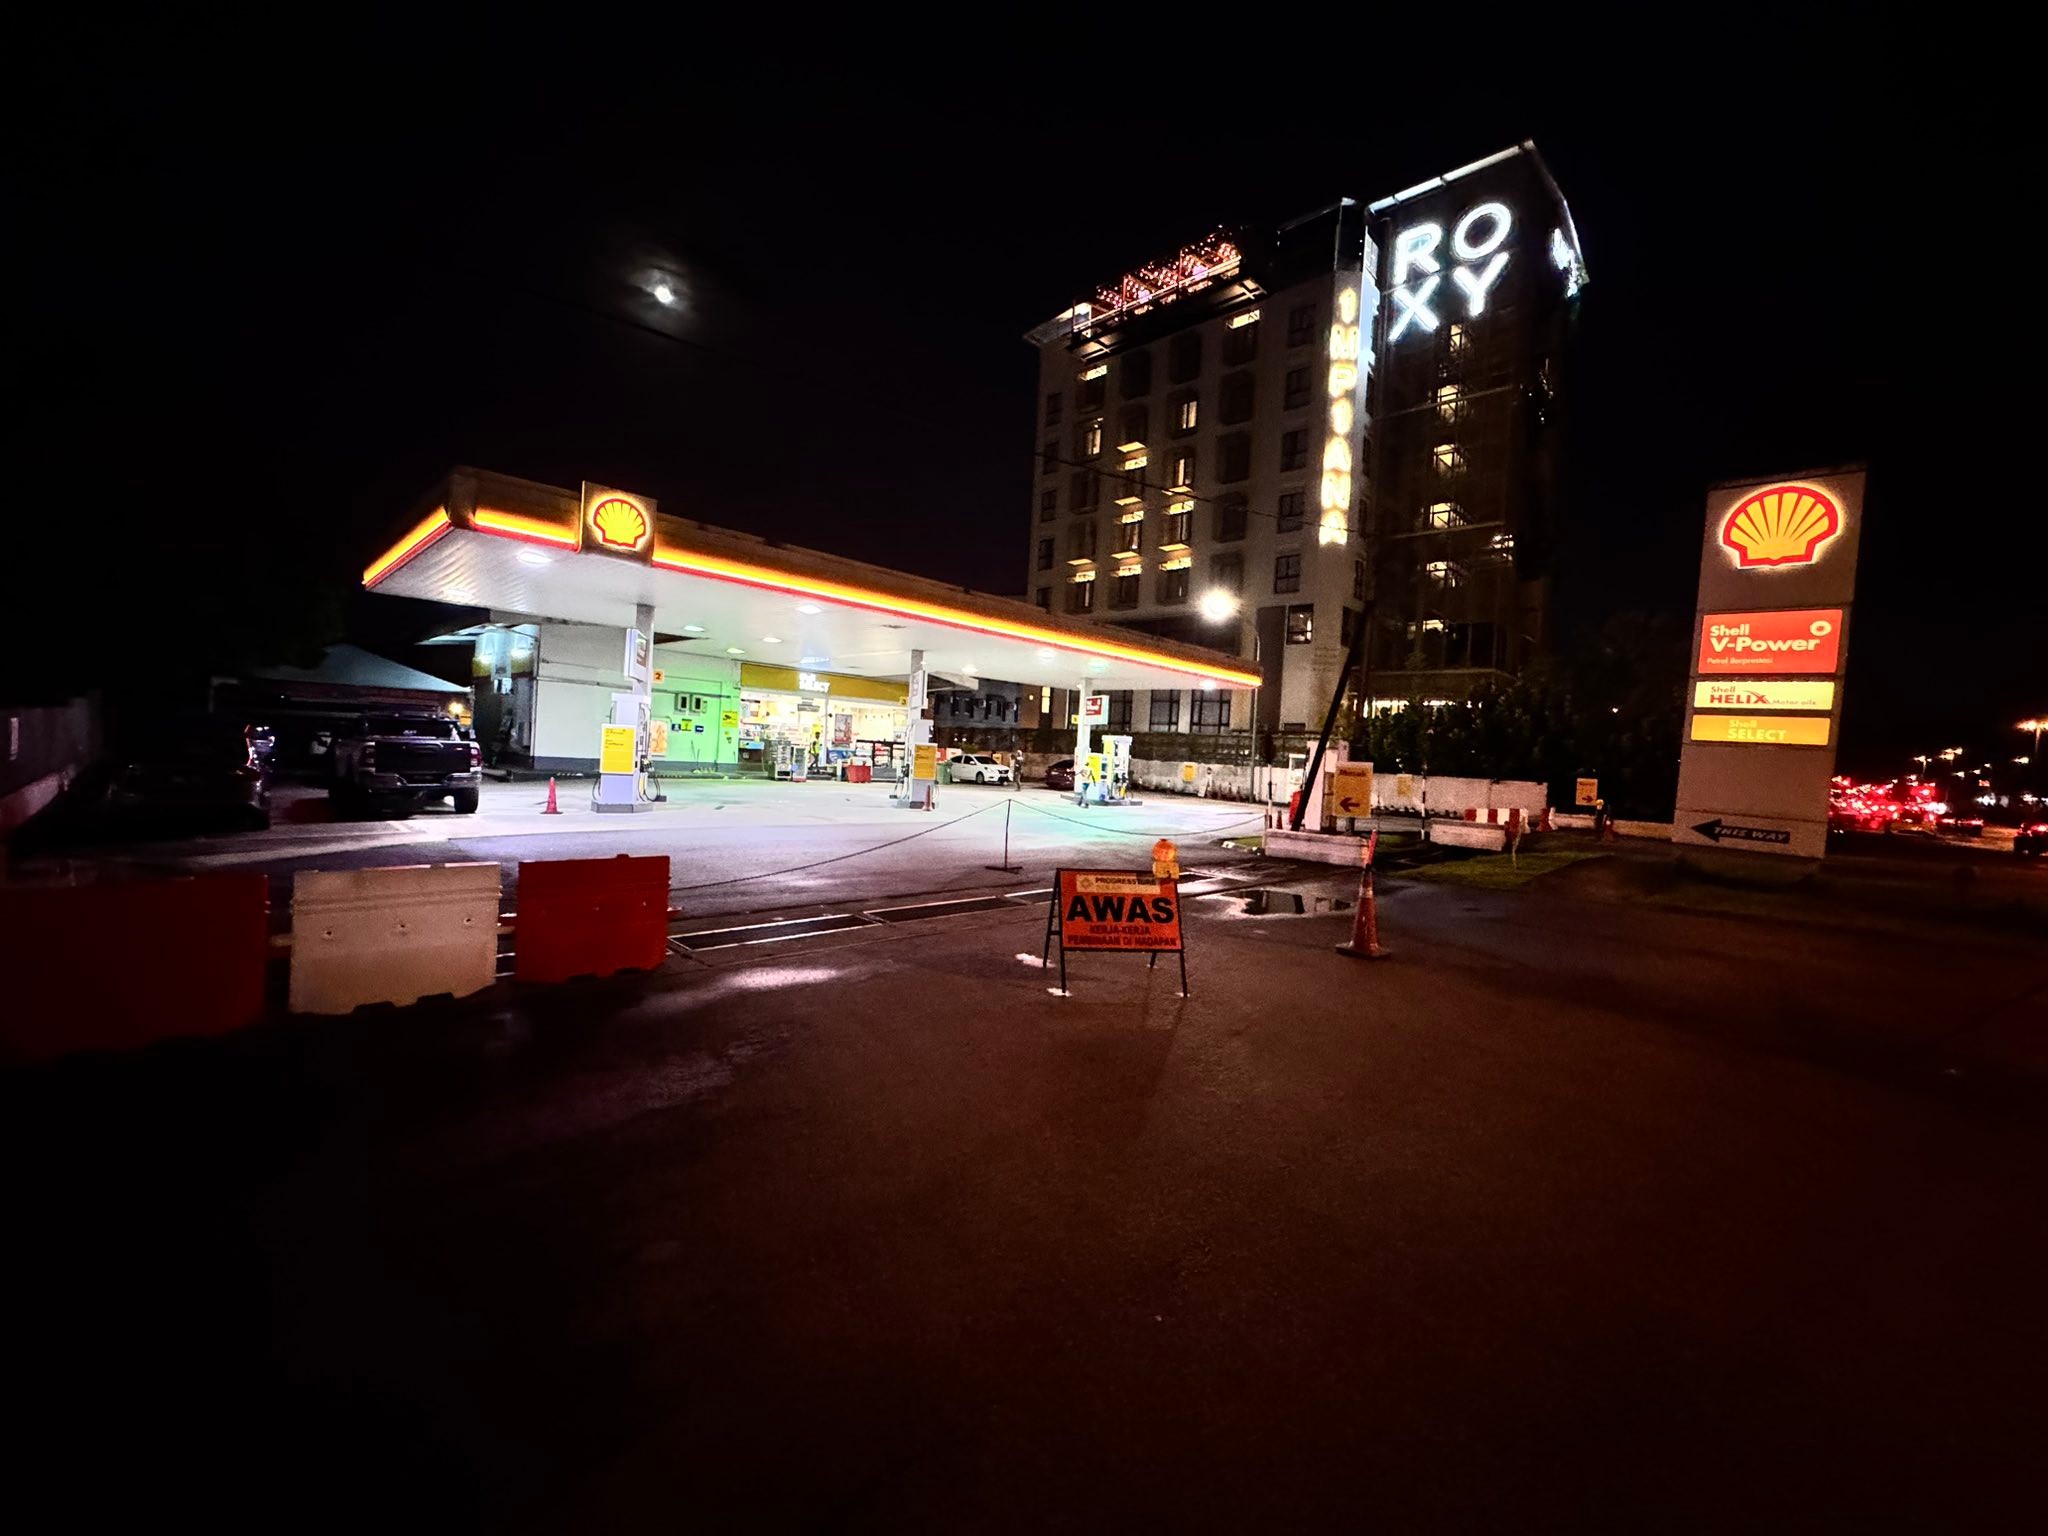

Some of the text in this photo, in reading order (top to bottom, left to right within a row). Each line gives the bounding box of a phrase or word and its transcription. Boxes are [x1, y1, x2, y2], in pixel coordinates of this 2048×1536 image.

[1710, 624, 1750, 637] Shell
[1710, 637, 1820, 652] V-Power
[655, 672, 661, 680] 2
[1710, 694, 1769, 704] HELIX
[1728, 719, 1758, 729] Shell
[1727, 728, 1787, 740] SELECT
[1713, 826, 1788, 841] THIS WAY
[1066, 895, 1175, 923] AWAS
